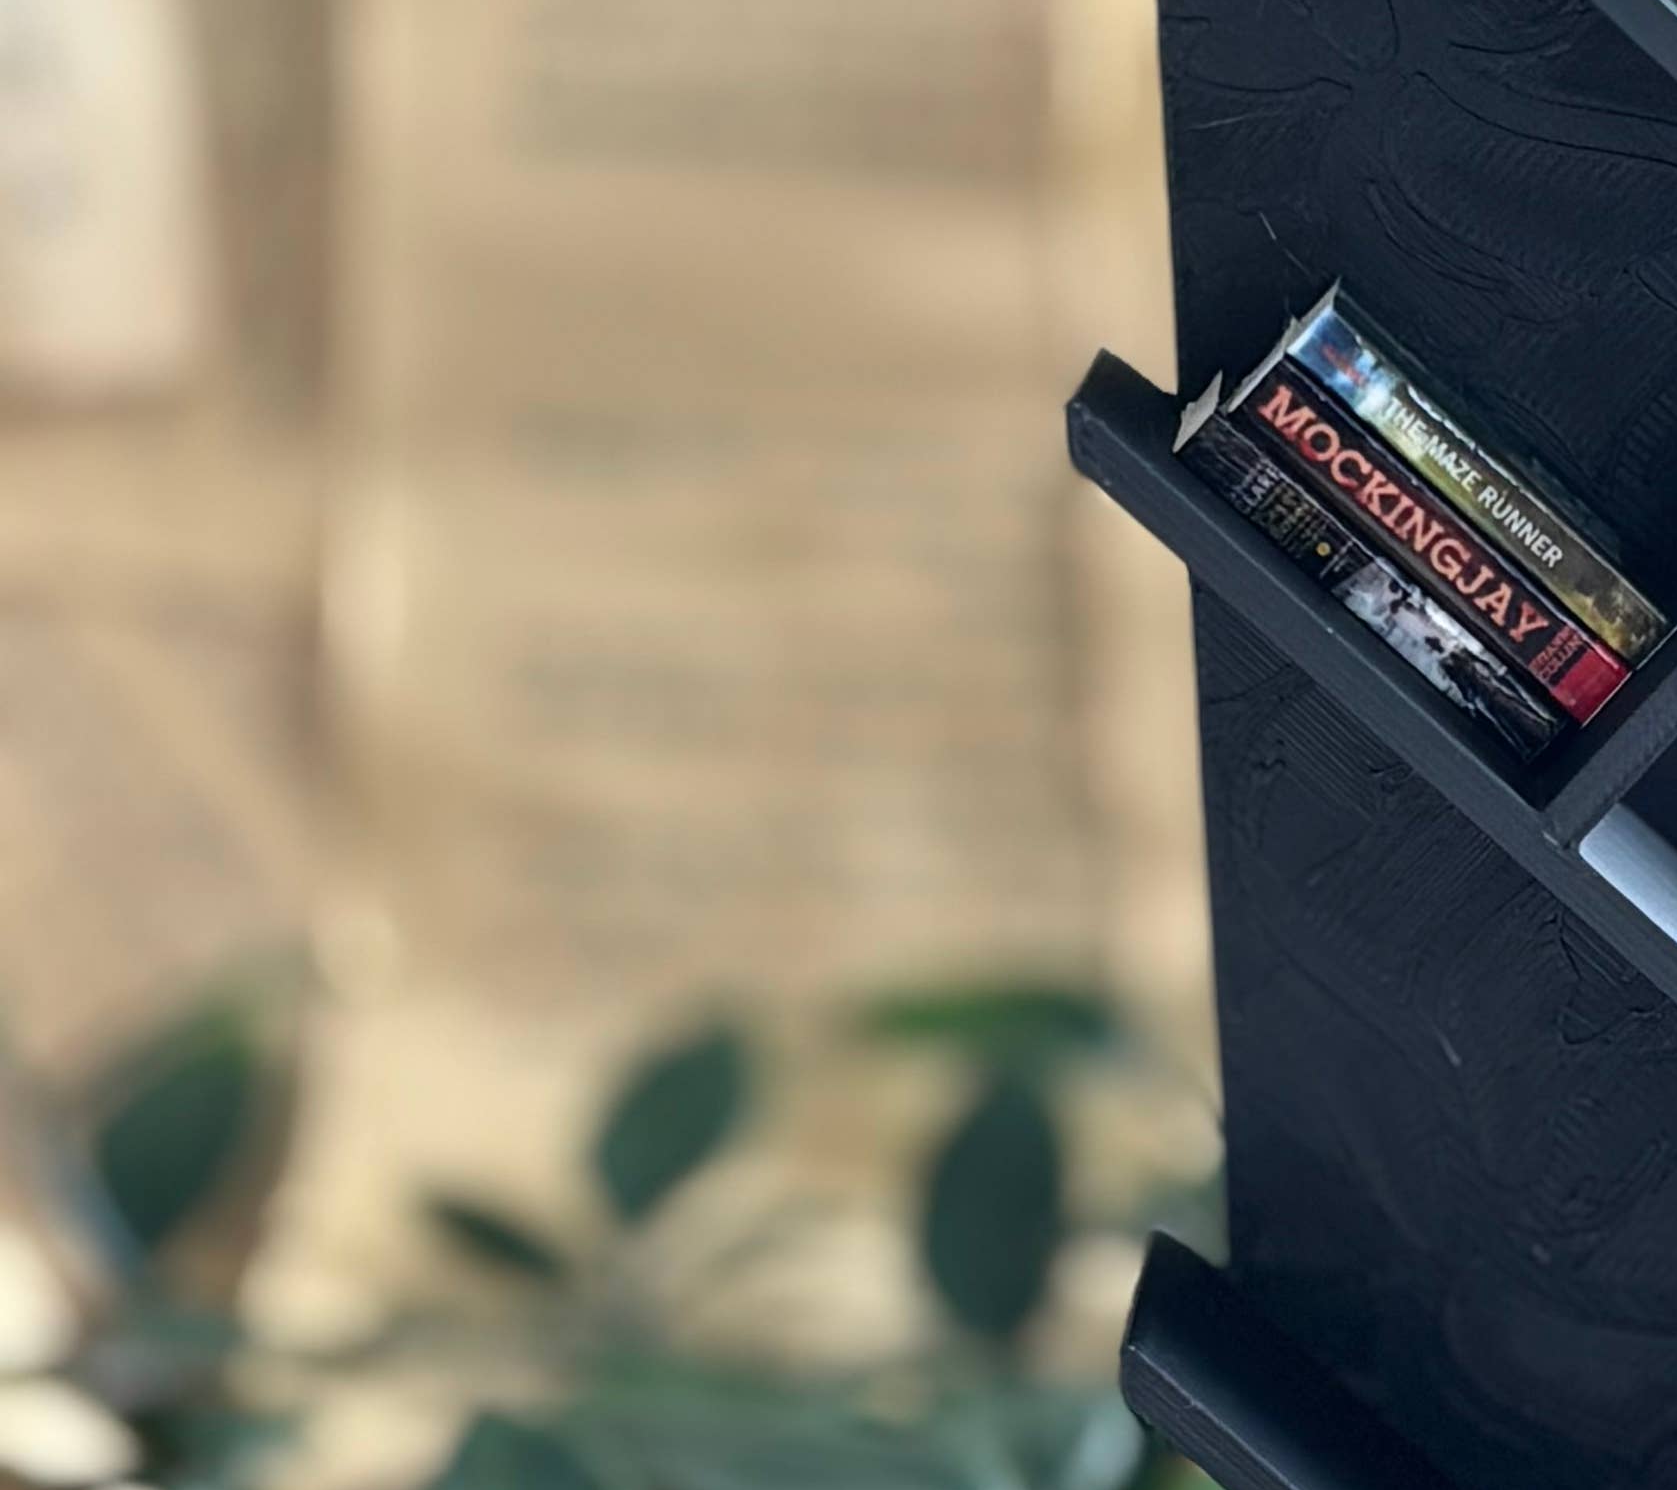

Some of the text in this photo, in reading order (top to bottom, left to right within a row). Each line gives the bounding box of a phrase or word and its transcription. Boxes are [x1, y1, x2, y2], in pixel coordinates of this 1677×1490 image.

[1254, 381, 1552, 652] MOCKINGJAY
[1379, 395, 1567, 570] THE MAZE RUNNER
